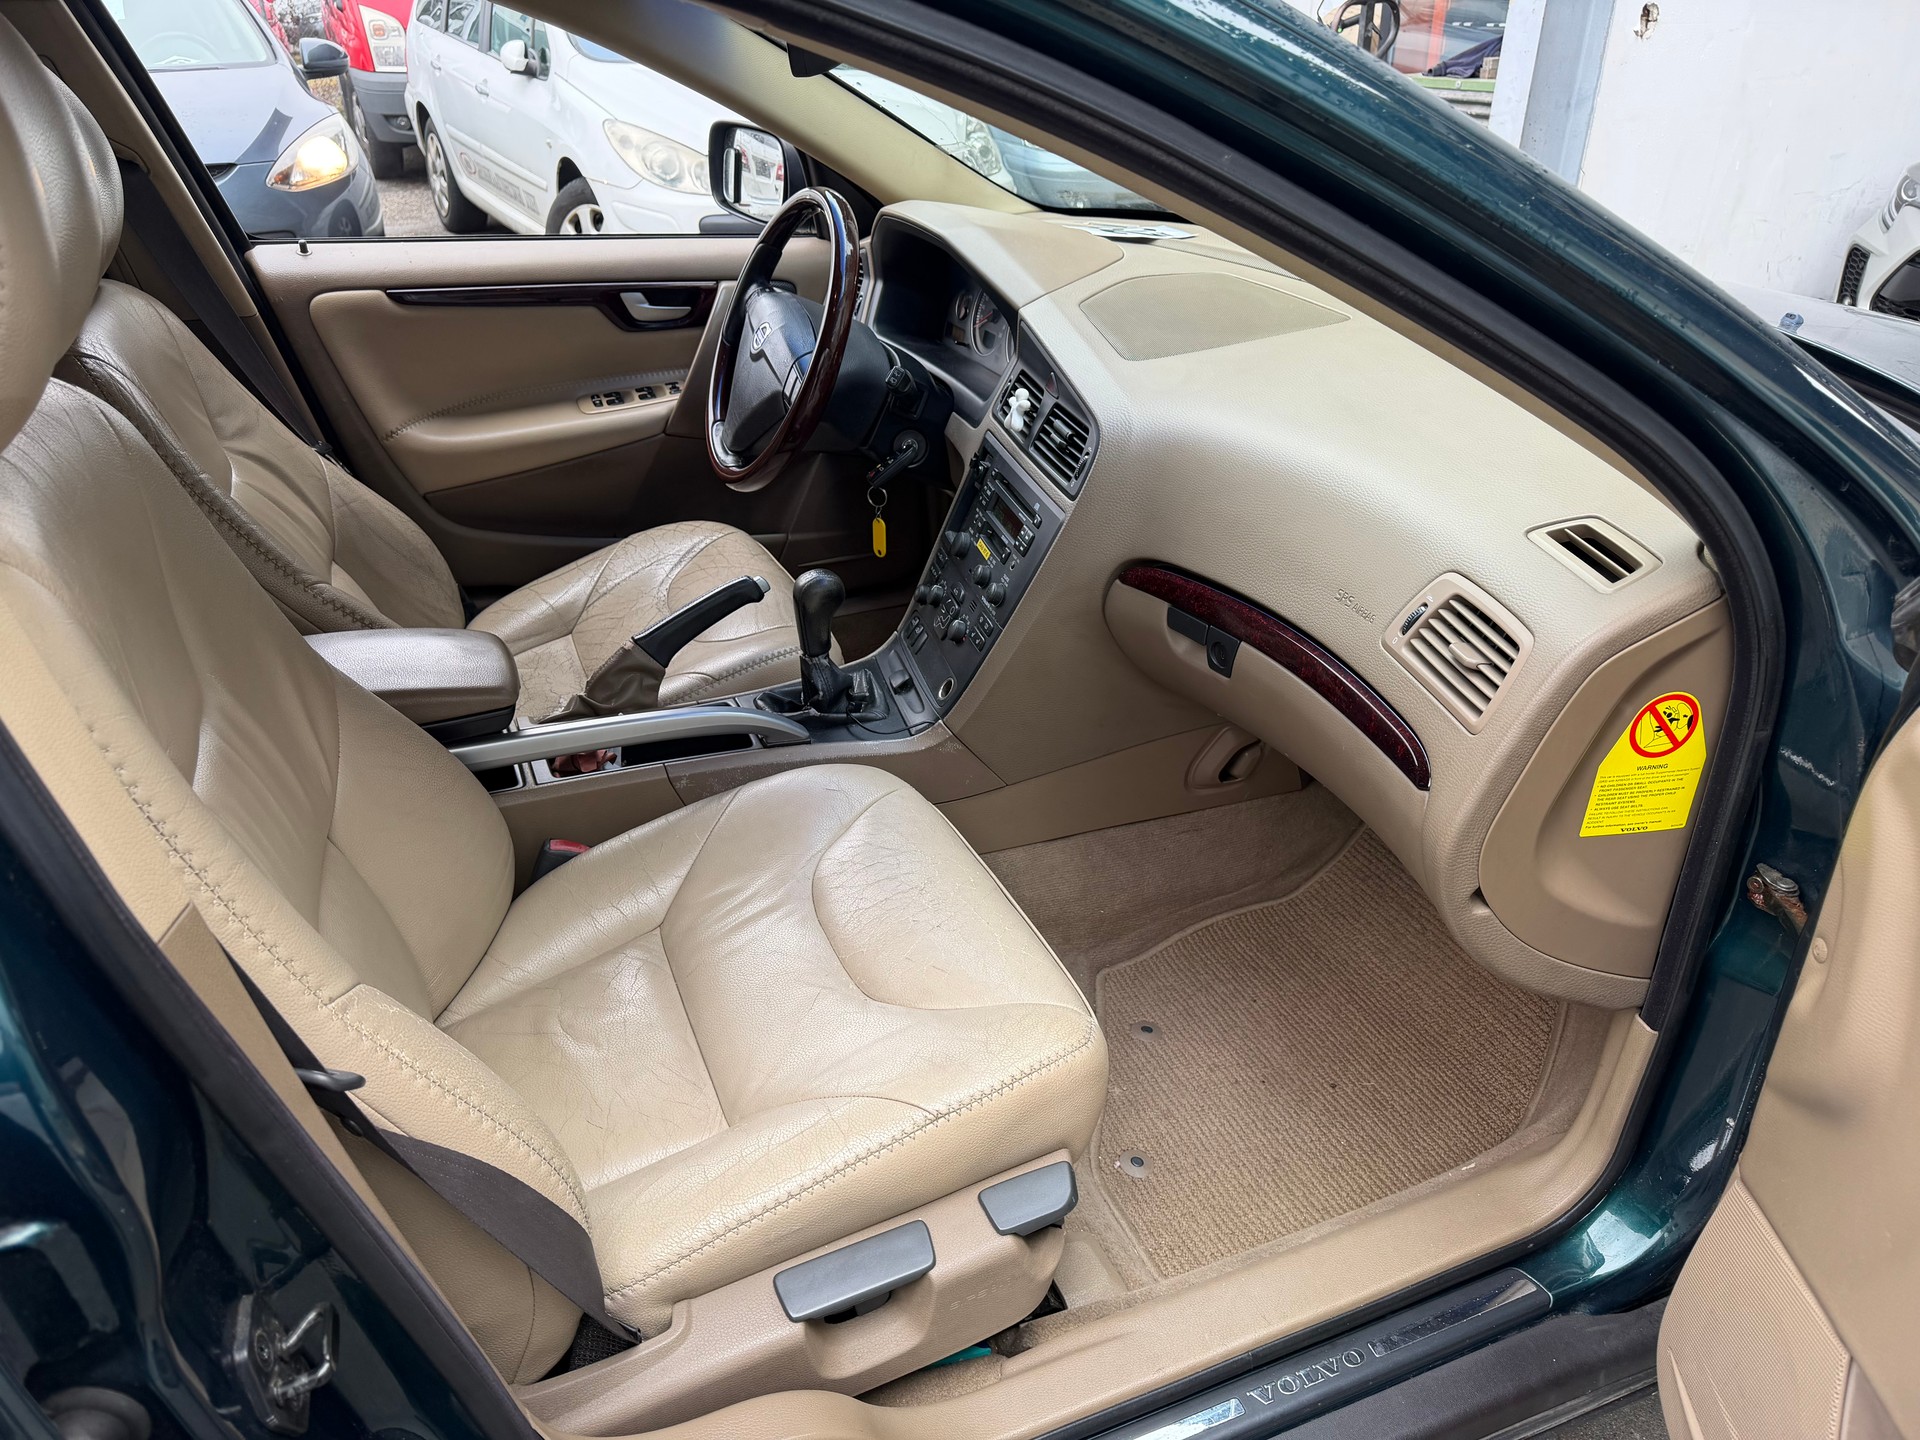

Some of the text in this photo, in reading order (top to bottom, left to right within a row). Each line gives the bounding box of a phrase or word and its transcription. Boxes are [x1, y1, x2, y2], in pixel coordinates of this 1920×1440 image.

[1334, 589, 1376, 623] SRS AIRBAG
[1246, 1347, 1366, 1405] VOLVO
